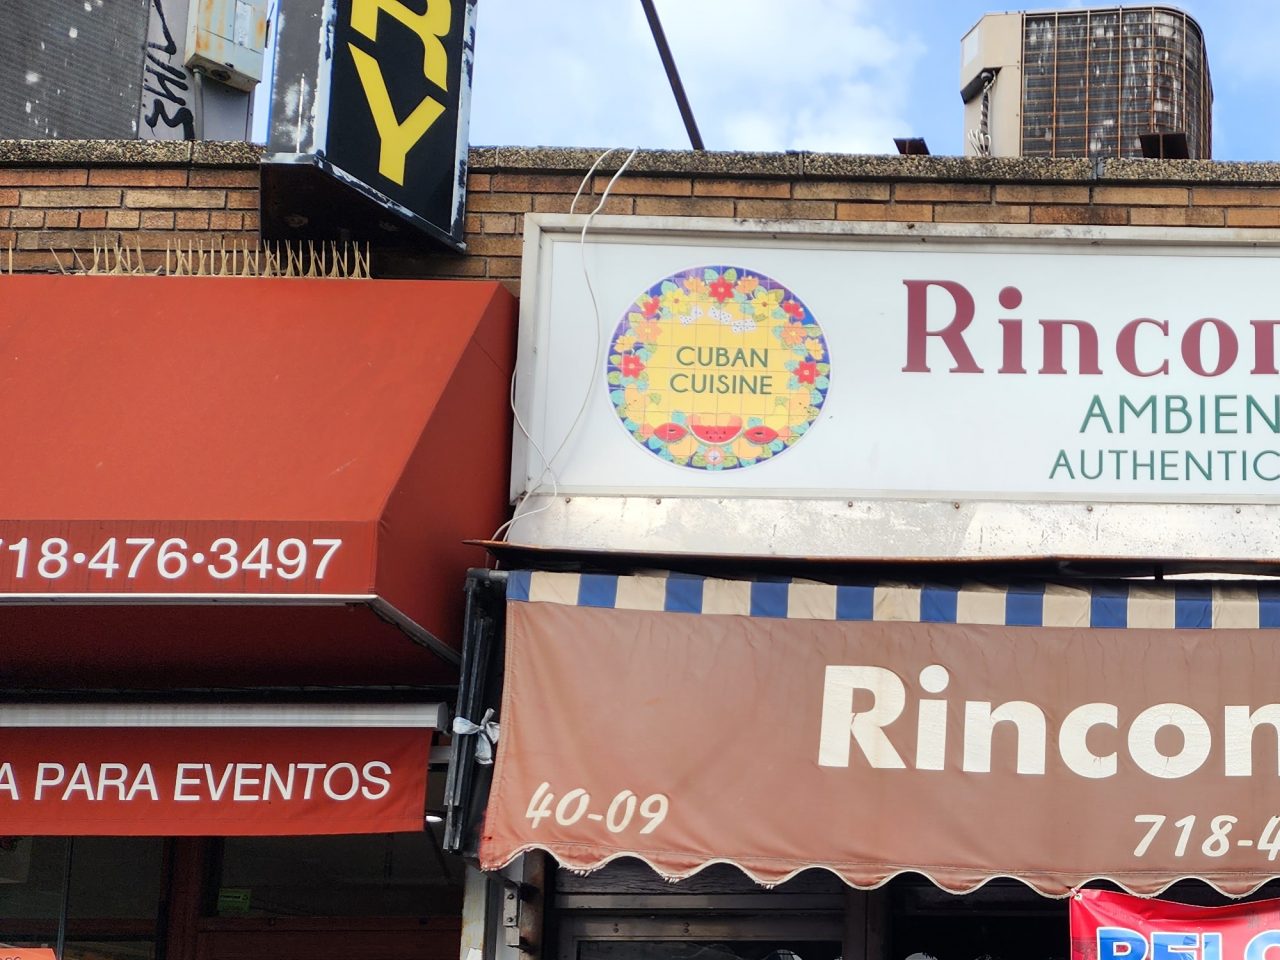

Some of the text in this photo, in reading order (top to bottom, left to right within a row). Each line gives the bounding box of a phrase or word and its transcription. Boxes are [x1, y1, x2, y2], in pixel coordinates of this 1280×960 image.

[676, 345, 769, 368] CUBAN
[669, 372, 773, 395] CUISINE
[34, 762, 158, 801] PARA
[174, 761, 392, 801] EVENTOS
[525, 781, 669, 836] 40-09
